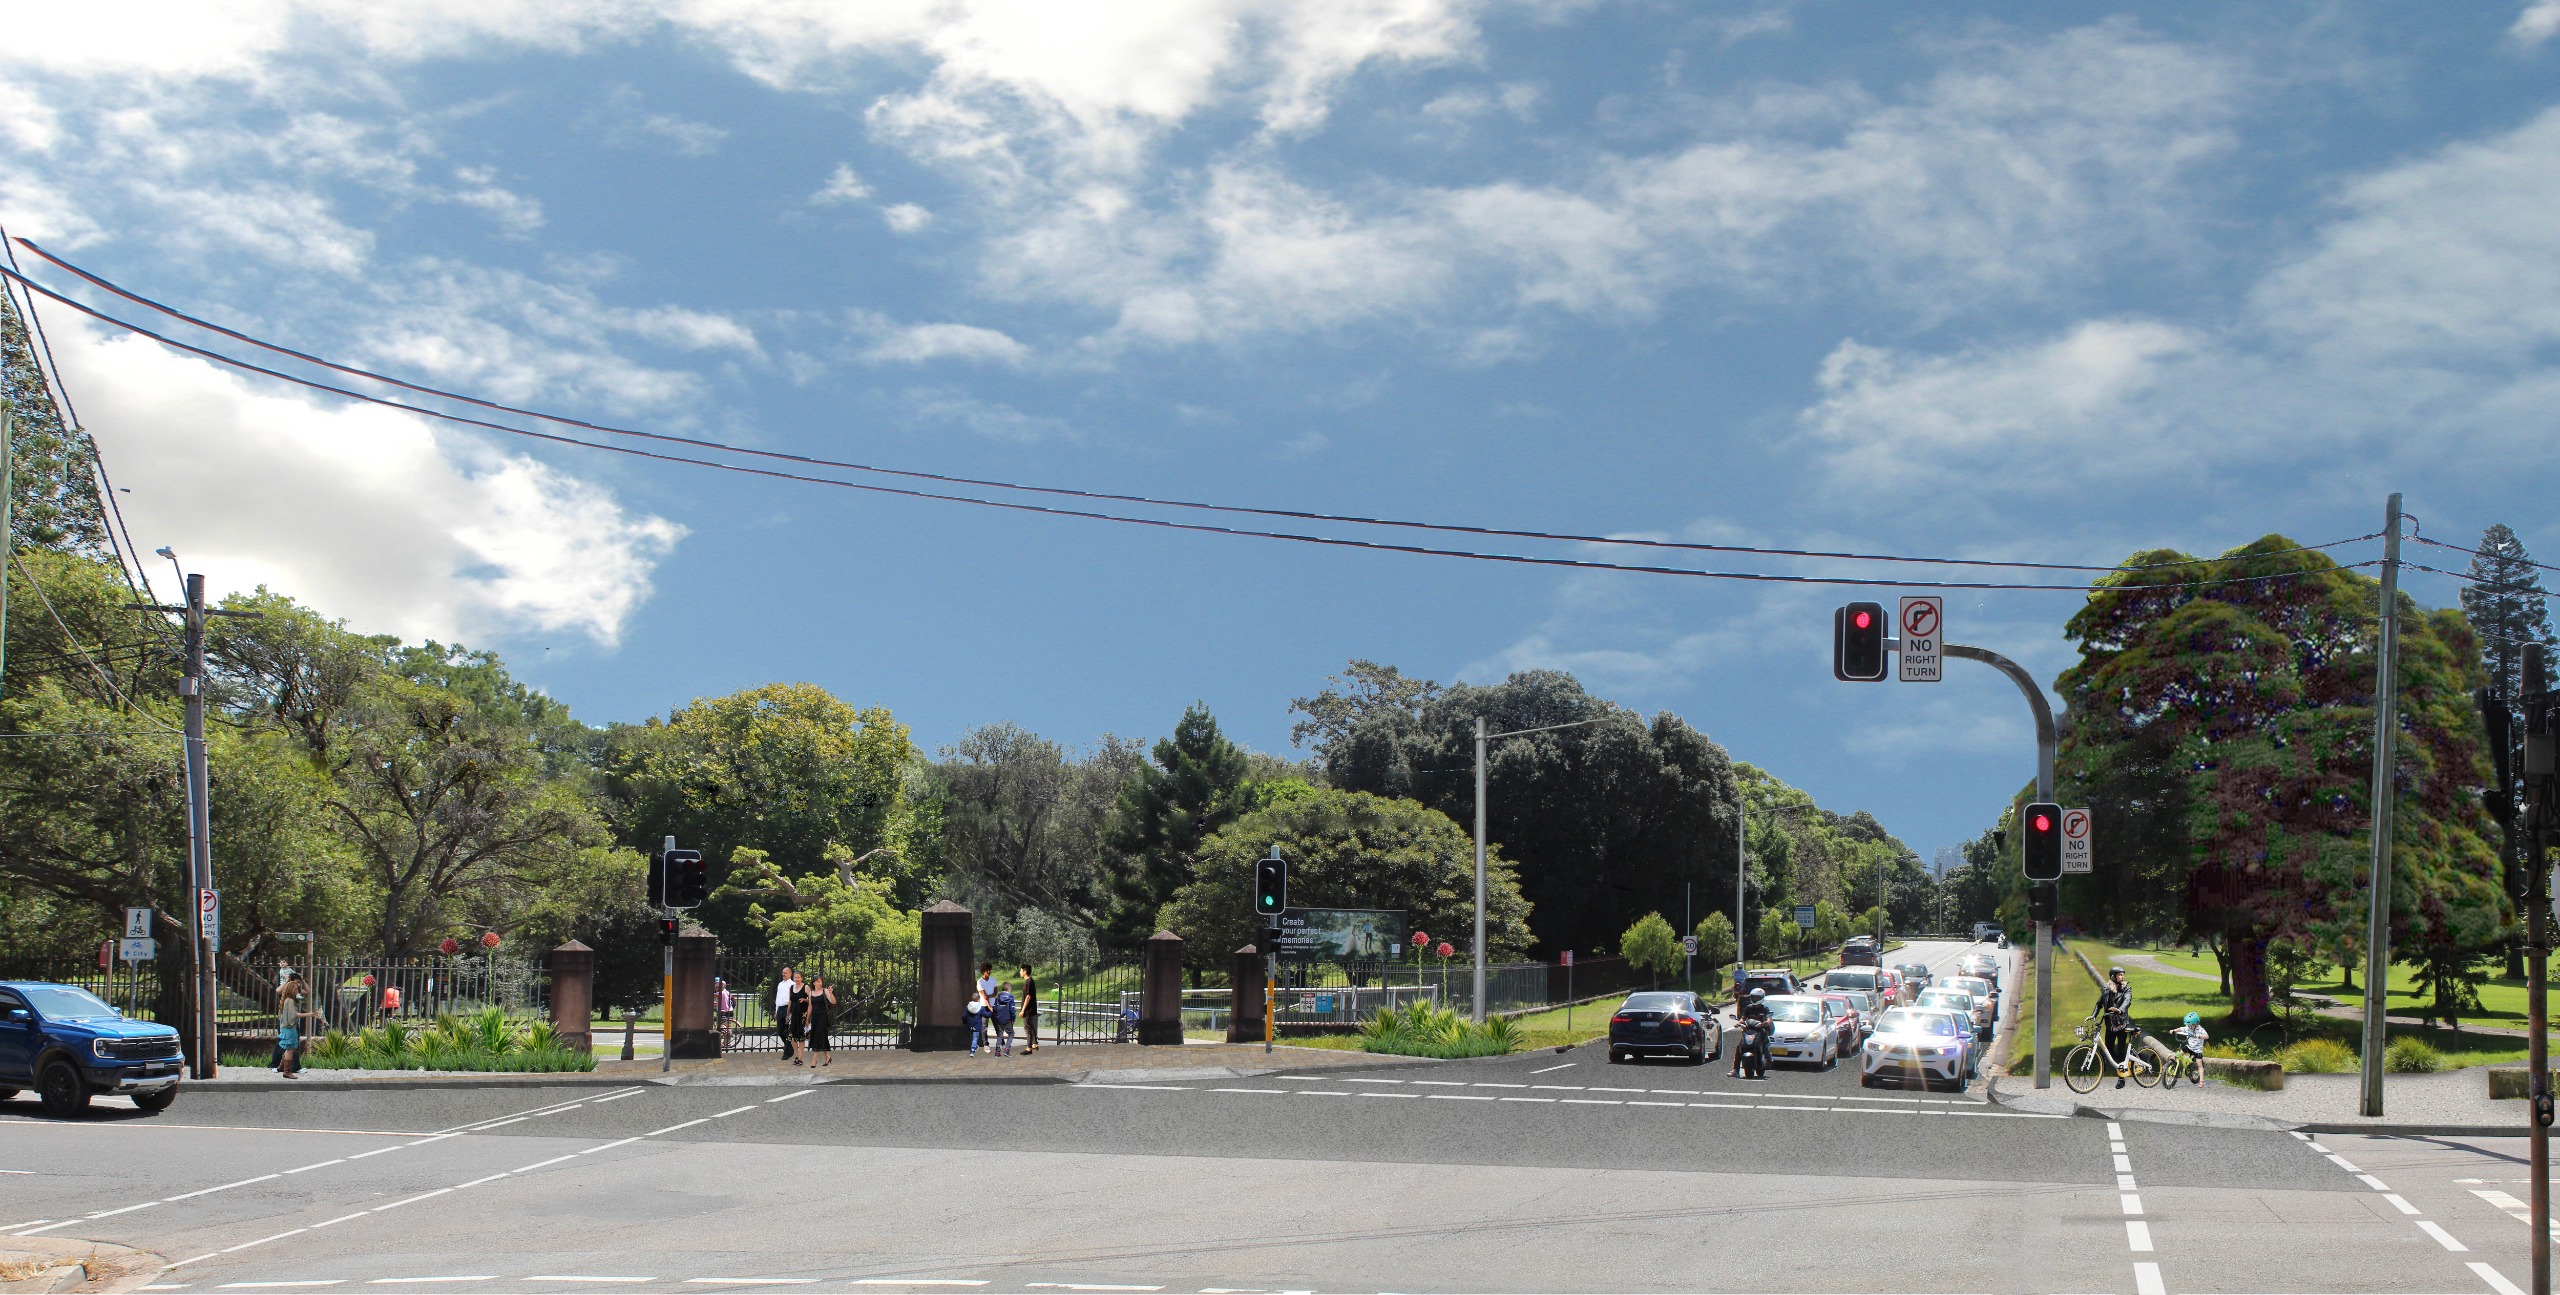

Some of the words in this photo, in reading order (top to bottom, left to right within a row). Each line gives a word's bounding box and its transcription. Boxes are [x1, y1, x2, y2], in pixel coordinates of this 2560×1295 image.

[1910, 639, 1932, 651] NO
[1905, 655, 1937, 664] RIGHT
[1906, 667, 1936, 676] TURN
[2069, 840, 2084, 850] NO
[1282, 917, 1305, 926] Create
[1281, 928, 1297, 936] your
[1297, 926, 1322, 936] perfect
